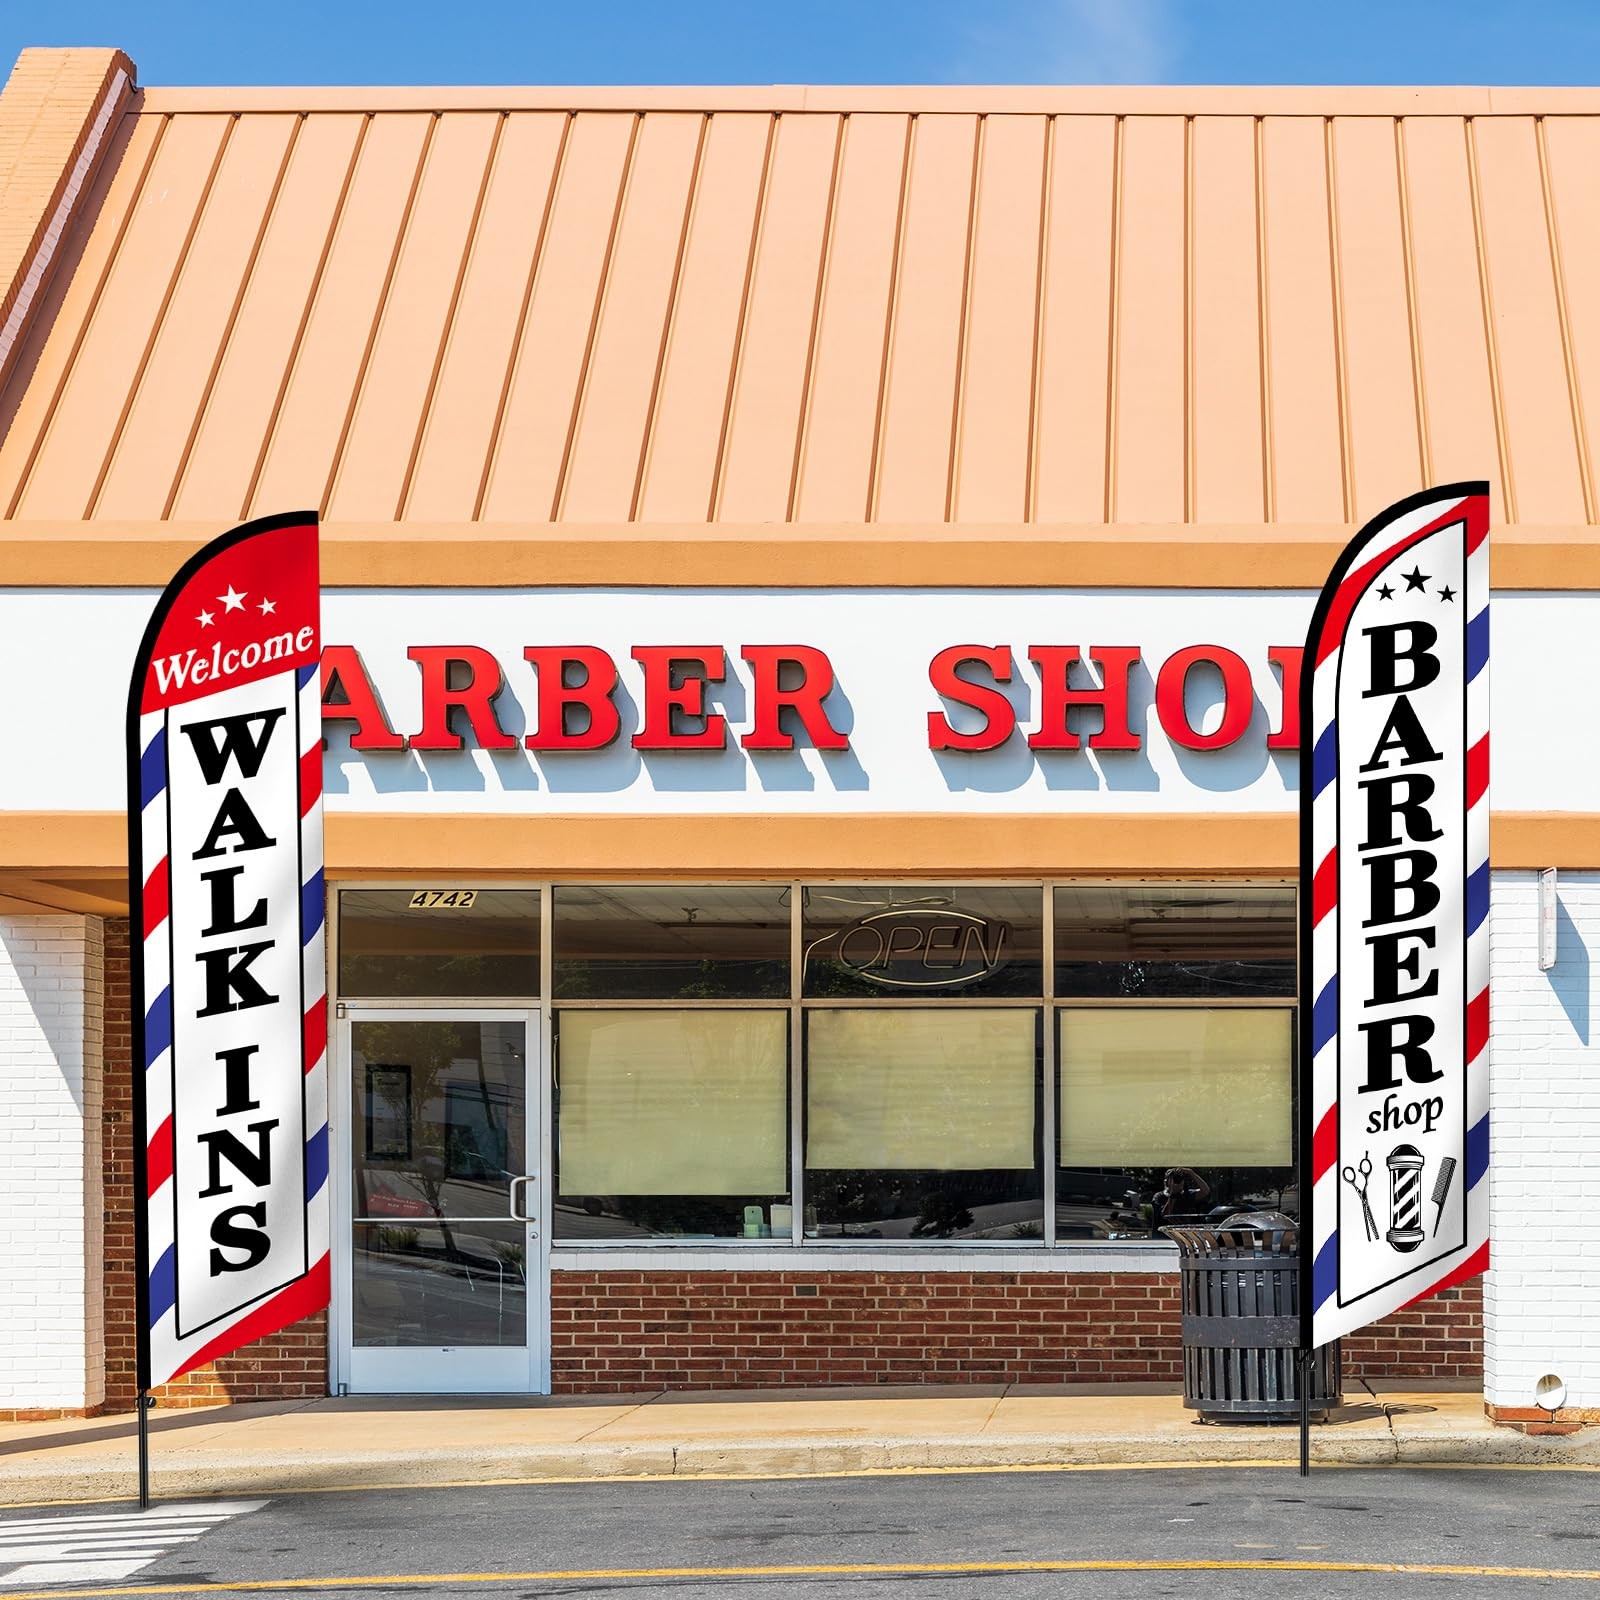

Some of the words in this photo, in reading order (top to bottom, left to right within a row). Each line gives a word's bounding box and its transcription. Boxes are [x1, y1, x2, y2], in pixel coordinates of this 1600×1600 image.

[152, 626, 314, 695] Welcome
[320, 645, 849, 752] ARBER
[180, 707, 286, 1018] WALK
[412, 892, 474, 907] 4742
[1358, 621, 1444, 1095] BARBER
[839, 926, 1007, 970] OPEN
[1366, 1093, 1444, 1134] shop
[197, 1044, 280, 1277] INS
